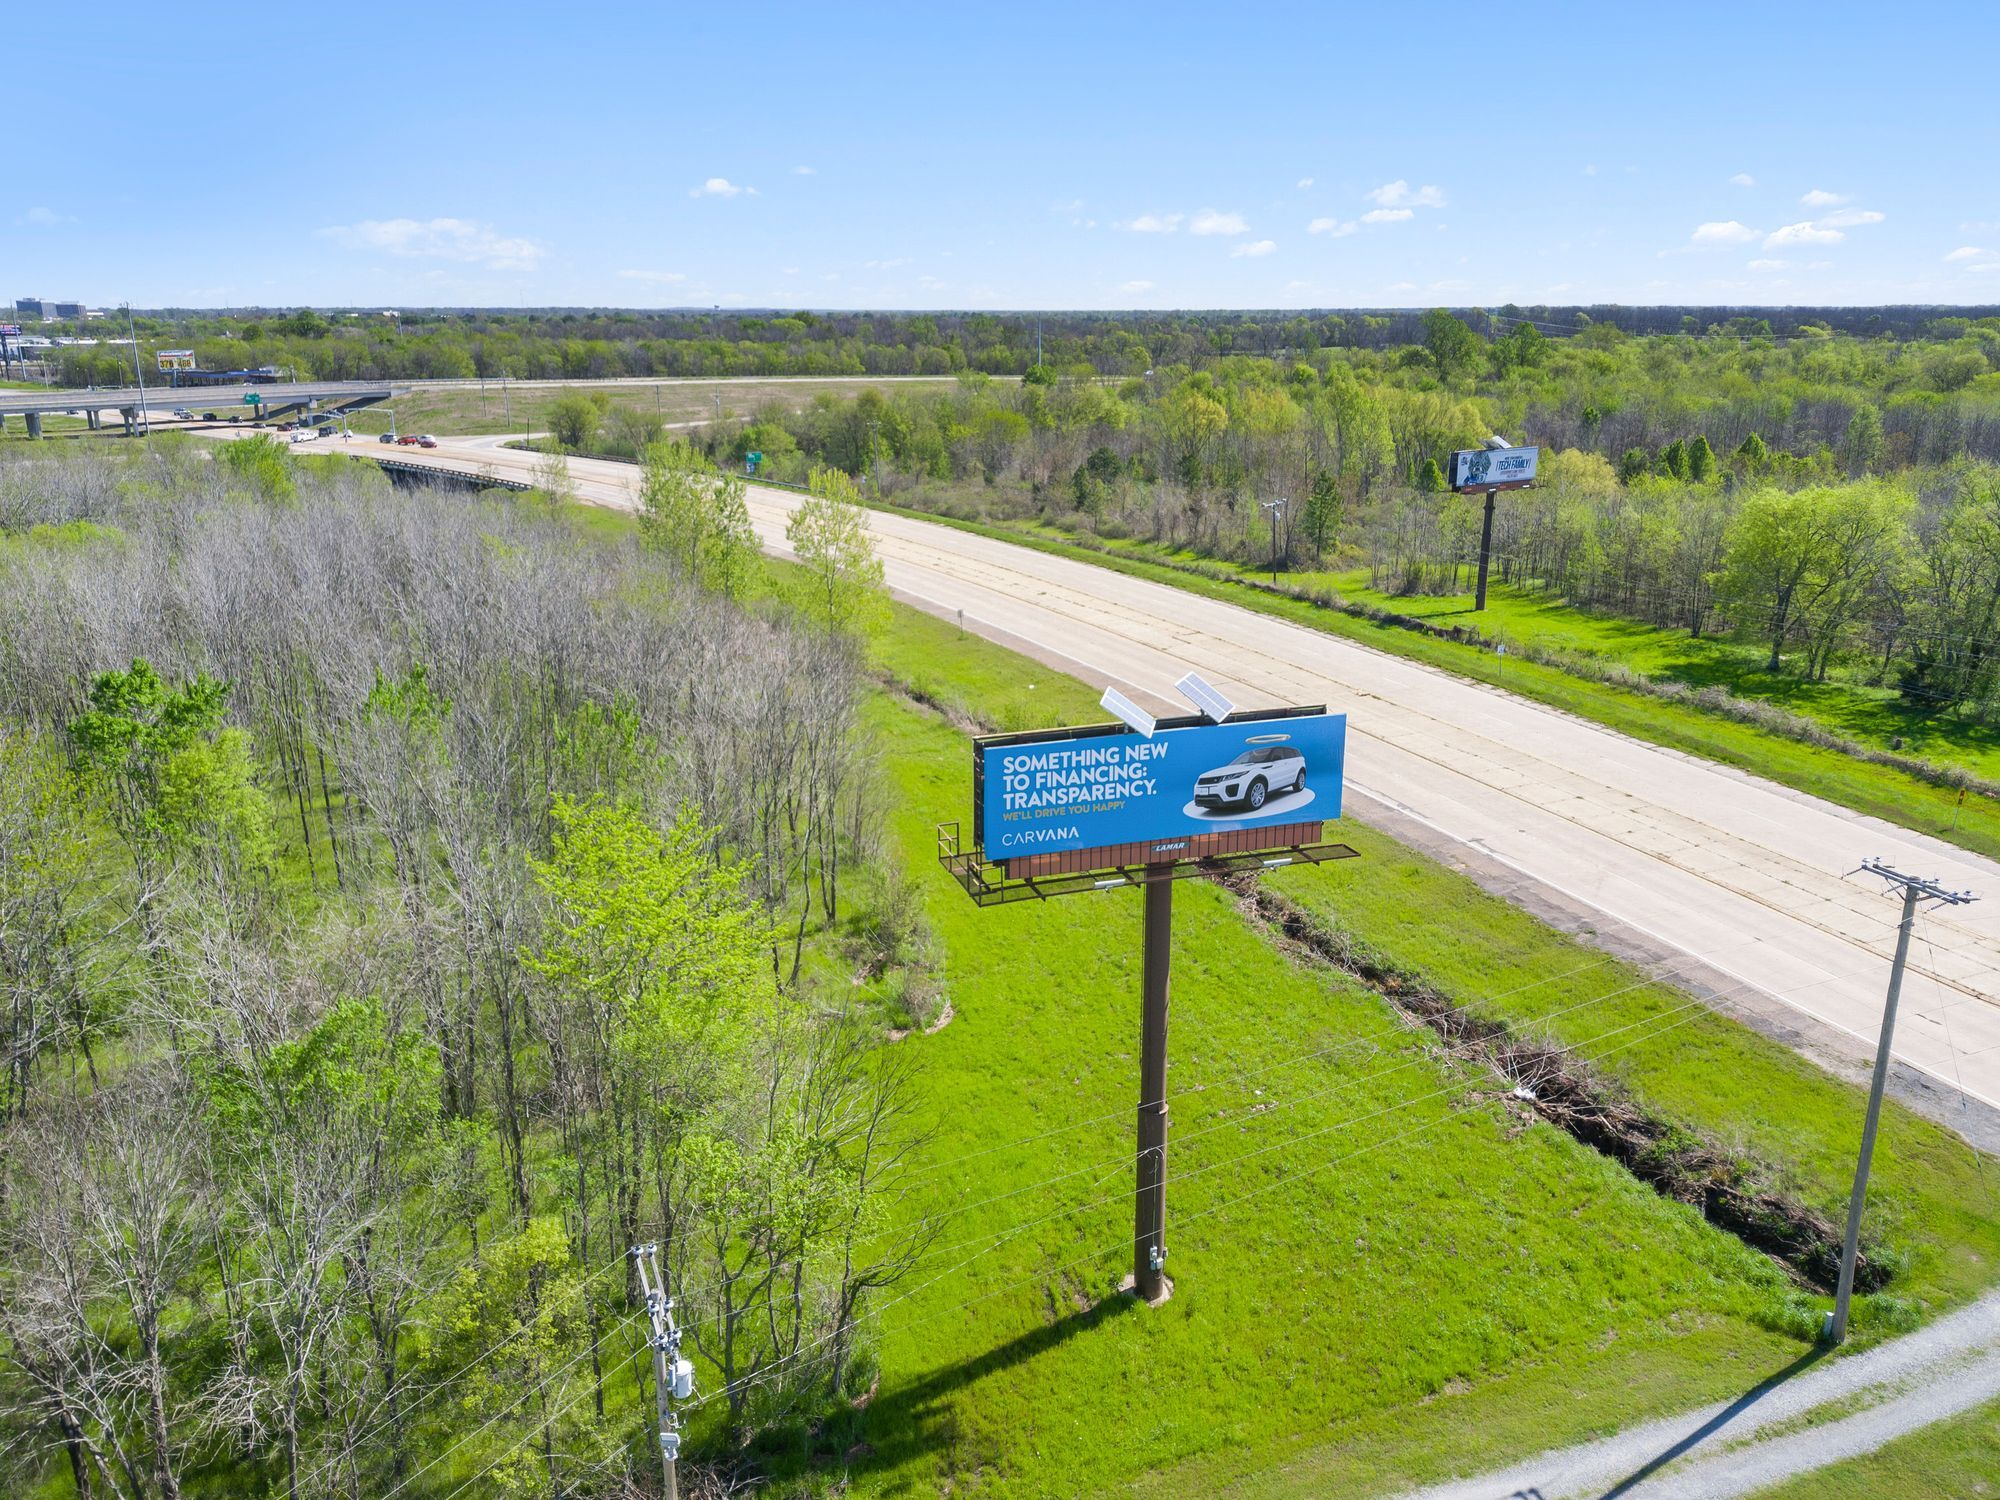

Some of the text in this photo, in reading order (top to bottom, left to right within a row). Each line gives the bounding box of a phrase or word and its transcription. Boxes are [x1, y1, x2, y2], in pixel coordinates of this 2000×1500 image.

[1003, 742, 1168, 774] SOMETHING NEW
[1003, 762, 1147, 792] TO FINANCING:
[1003, 779, 1157, 810] TRANSPARENCY.
[1003, 801, 1125, 821] WE'LL DRIVE YOU HAPPY
[1002, 826, 1079, 846] CARVANA
[1156, 842, 1185, 851] LAMAR
